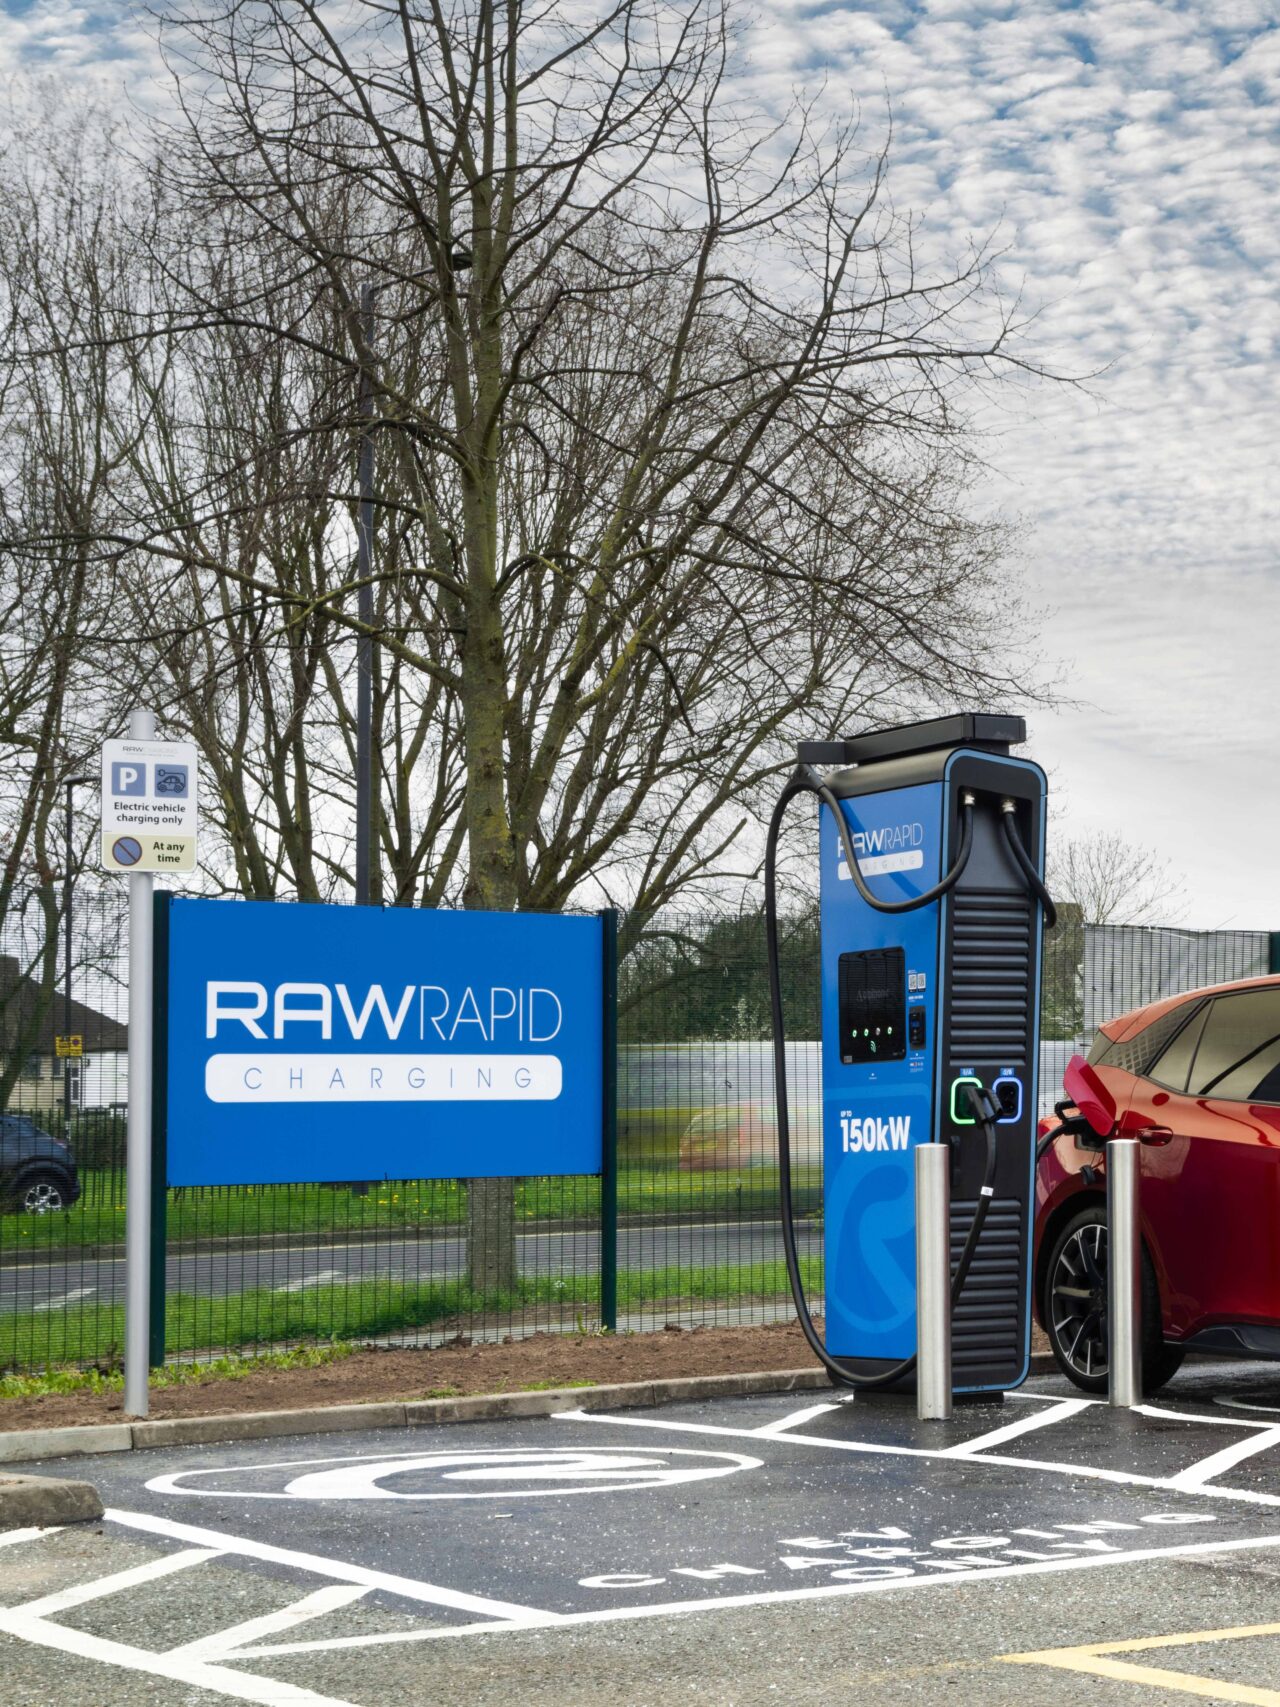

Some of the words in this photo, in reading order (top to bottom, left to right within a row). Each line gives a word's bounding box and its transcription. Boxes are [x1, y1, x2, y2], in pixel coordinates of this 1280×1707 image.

[120, 767, 138, 791] P
[114, 802, 150, 812] Electric
[152, 803, 186, 813] vehicle
[116, 814, 160, 825] charging
[162, 815, 183, 825] only
[153, 842, 164, 850] At
[166, 844, 185, 853] any
[158, 854, 180, 863] time
[244, 1067, 532, 1089] CHARGING
[840, 1116, 911, 1152] 150kW
[778, 1527, 912, 1549] EV
[577, 1514, 1218, 1588] CHARGING
[830, 1539, 1124, 1580] ONLY
